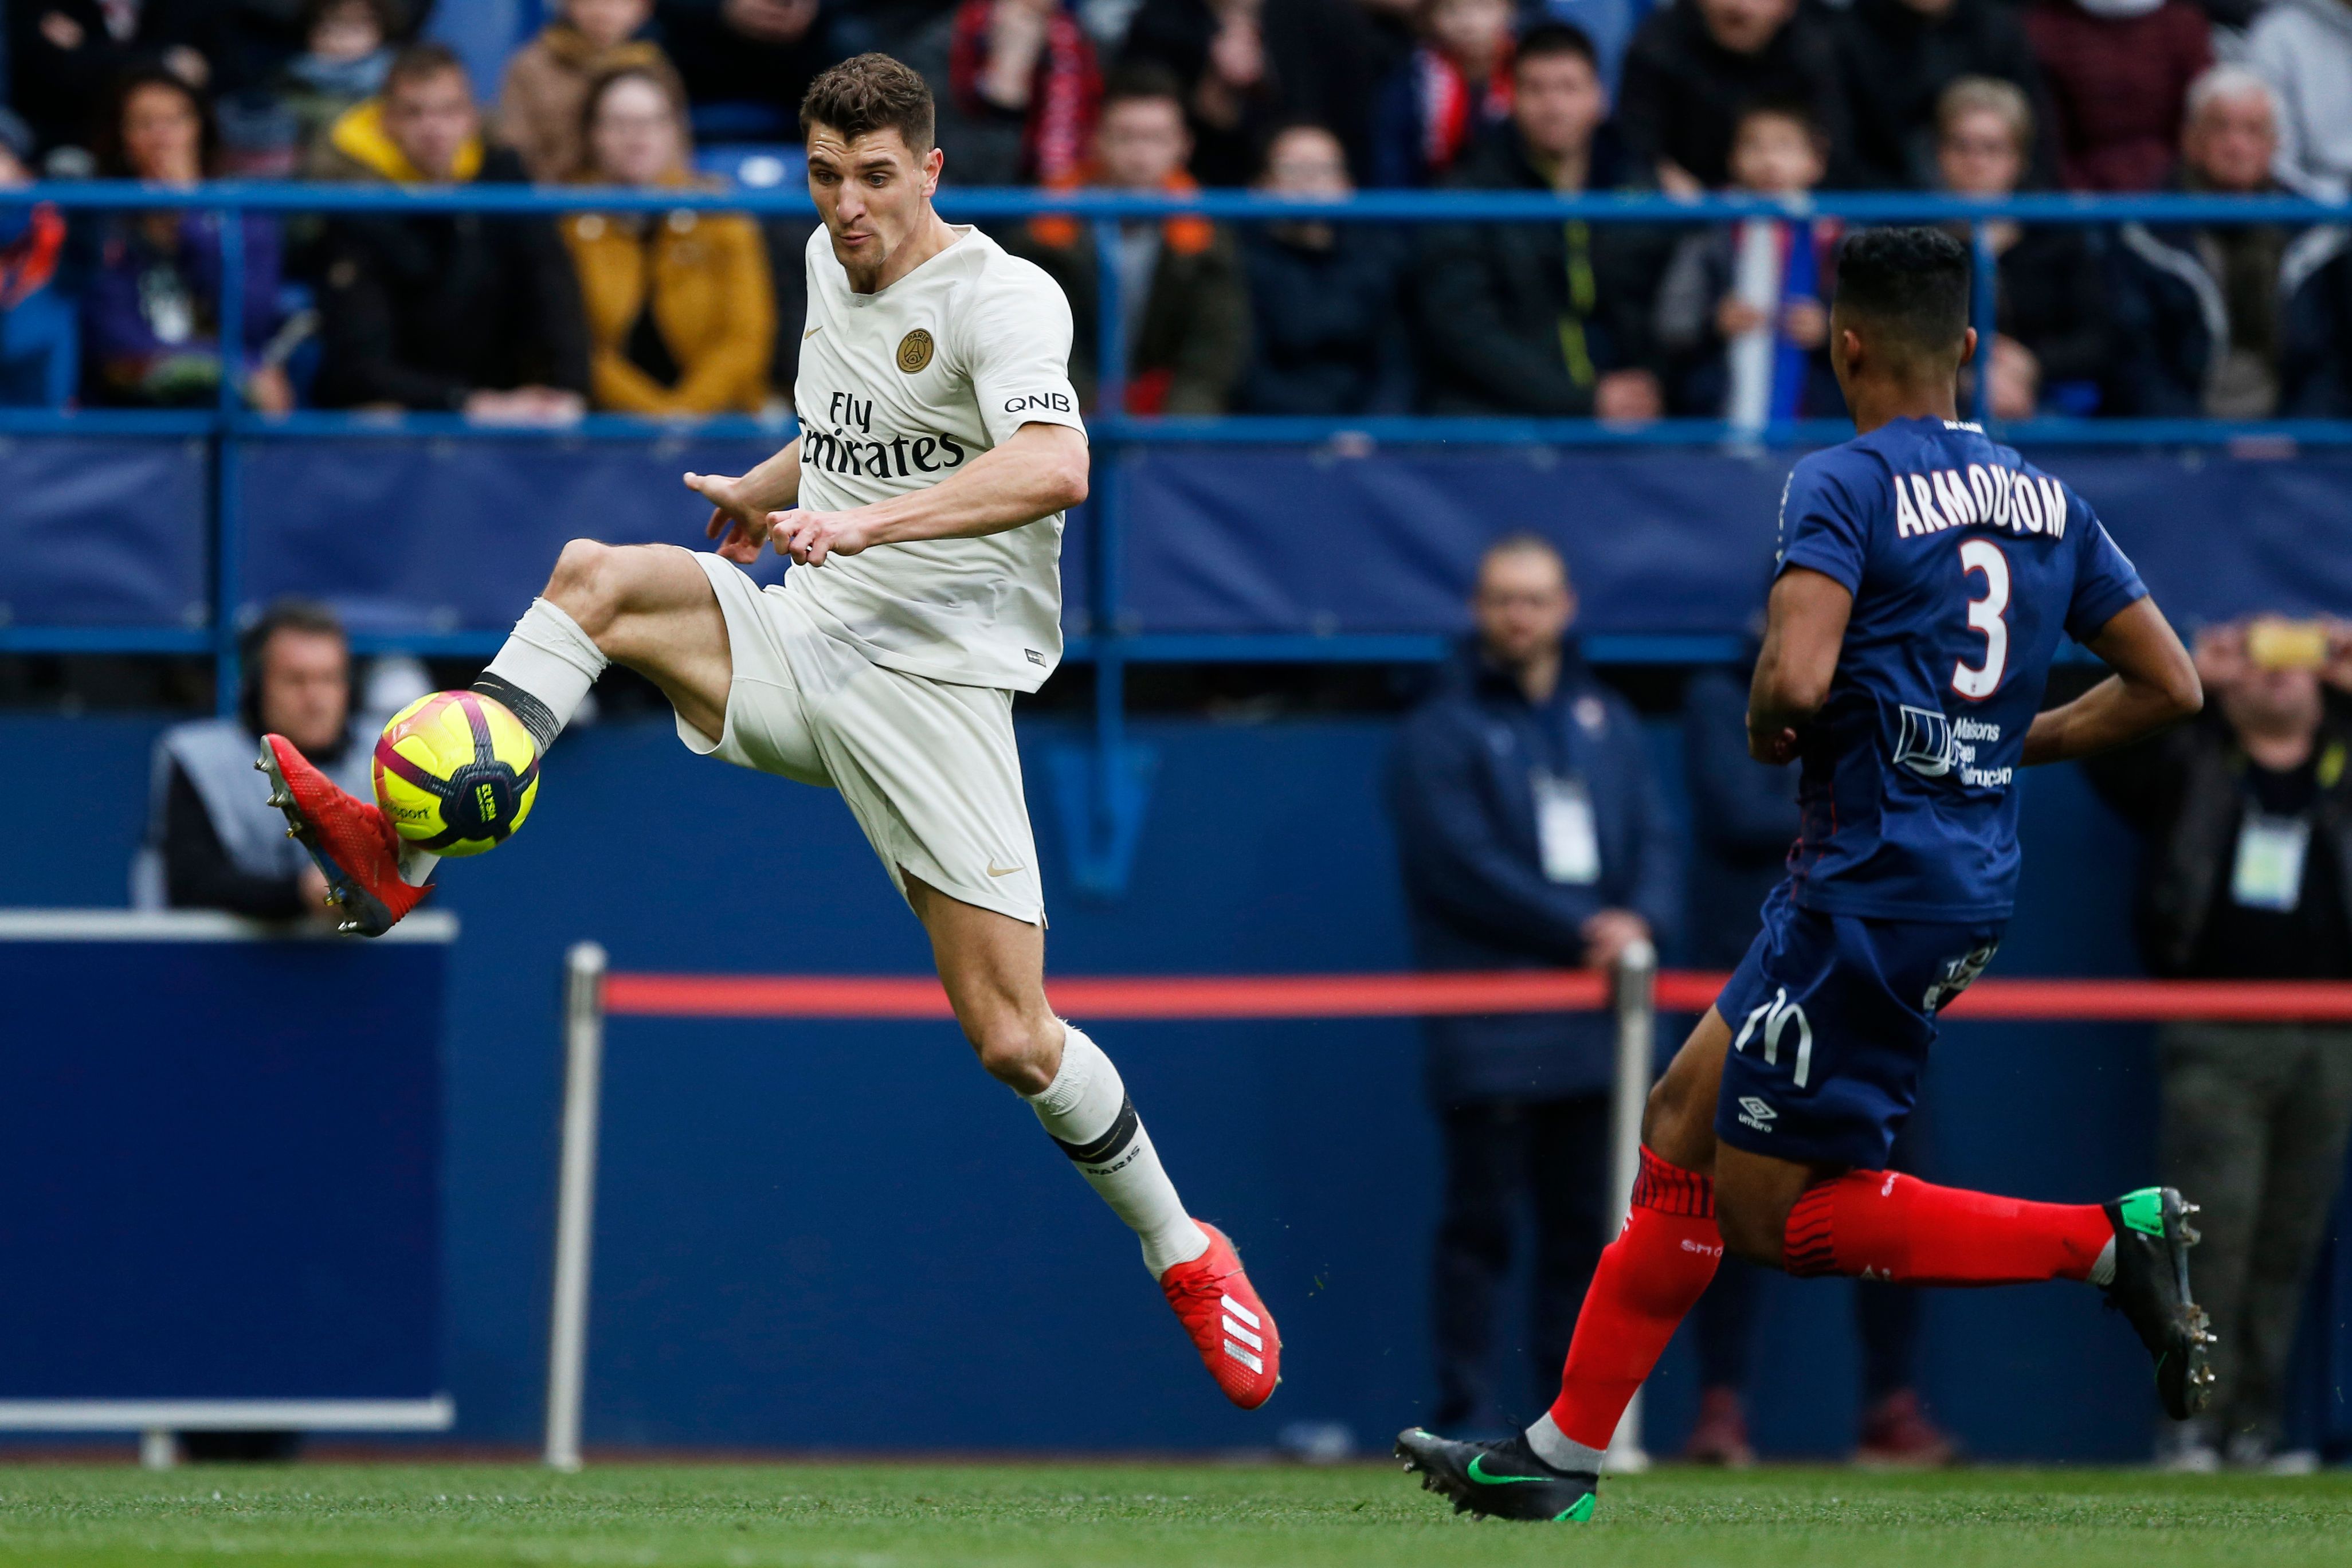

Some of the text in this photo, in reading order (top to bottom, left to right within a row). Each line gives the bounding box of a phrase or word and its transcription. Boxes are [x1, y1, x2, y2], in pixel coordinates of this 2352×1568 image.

[907, 332, 930, 343] PARIS
[830, 392, 872, 433] Fly
[1005, 393, 1070, 412] QNB
[1951, 538, 2012, 701] 3
[1739, 1113, 1772, 1133] umbro
[1087, 1145, 1139, 1175] PARIS
